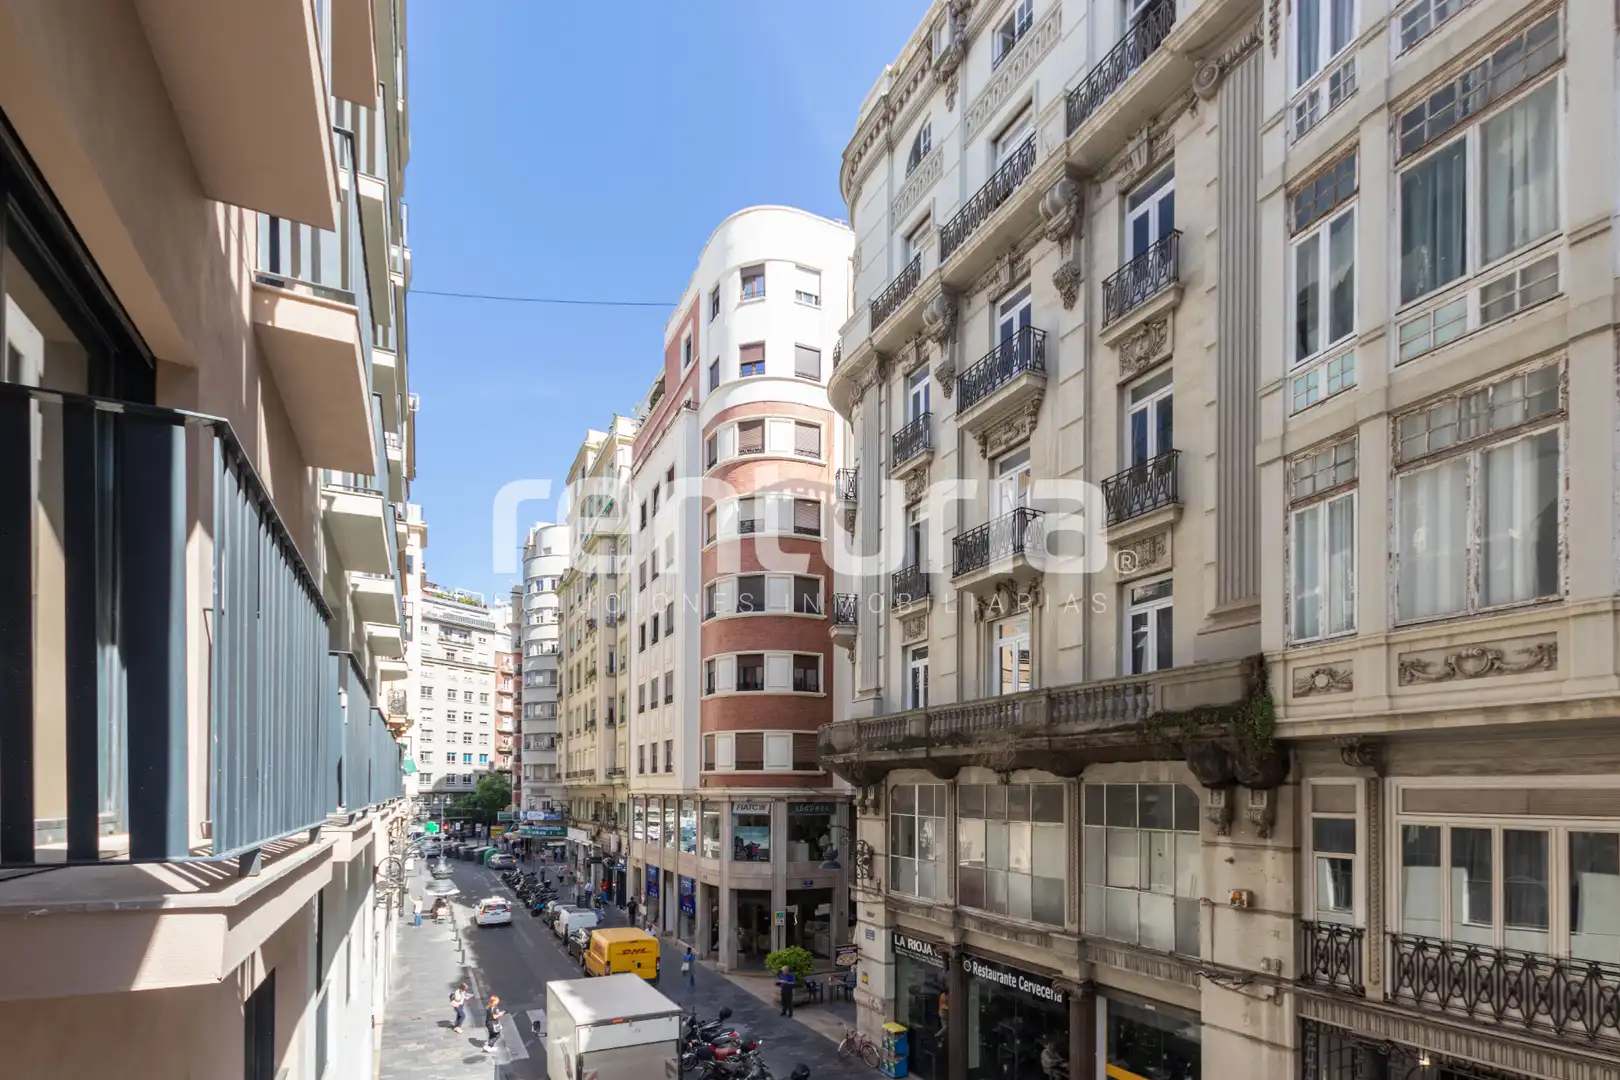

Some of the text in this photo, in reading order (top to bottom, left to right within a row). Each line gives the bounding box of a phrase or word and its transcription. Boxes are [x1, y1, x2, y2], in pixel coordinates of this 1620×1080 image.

[894, 934, 906, 948] LA
[907, 938, 933, 956] RIOJA
[972, 961, 1017, 988] Restaurante
